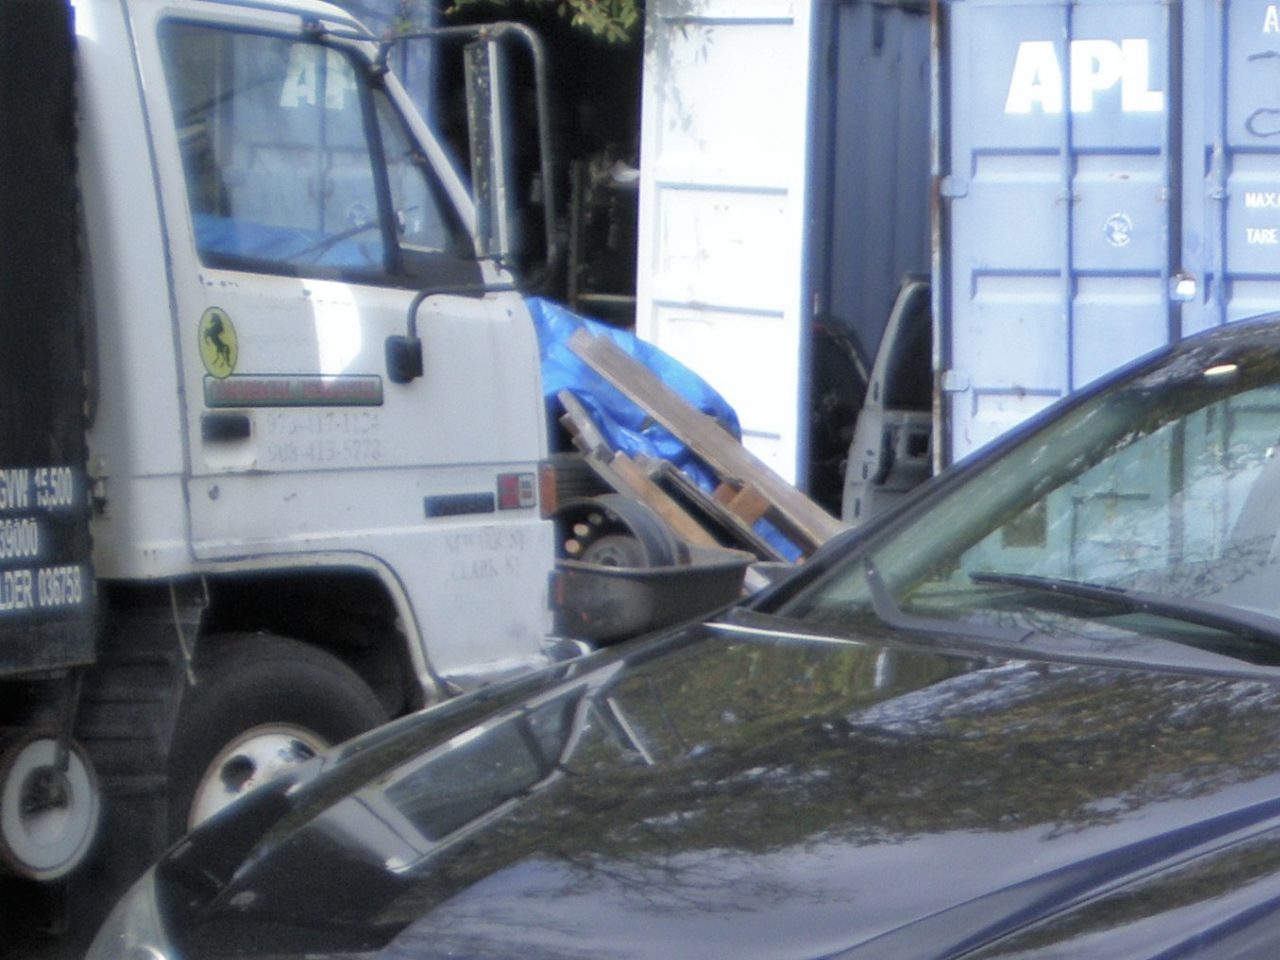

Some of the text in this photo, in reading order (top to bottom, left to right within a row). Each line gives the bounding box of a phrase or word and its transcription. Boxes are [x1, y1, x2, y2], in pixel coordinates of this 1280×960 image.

[1004, 38, 1164, 113] APL
[1246, 228, 1279, 244] TARE
[38, 565, 82, 606] 036758
